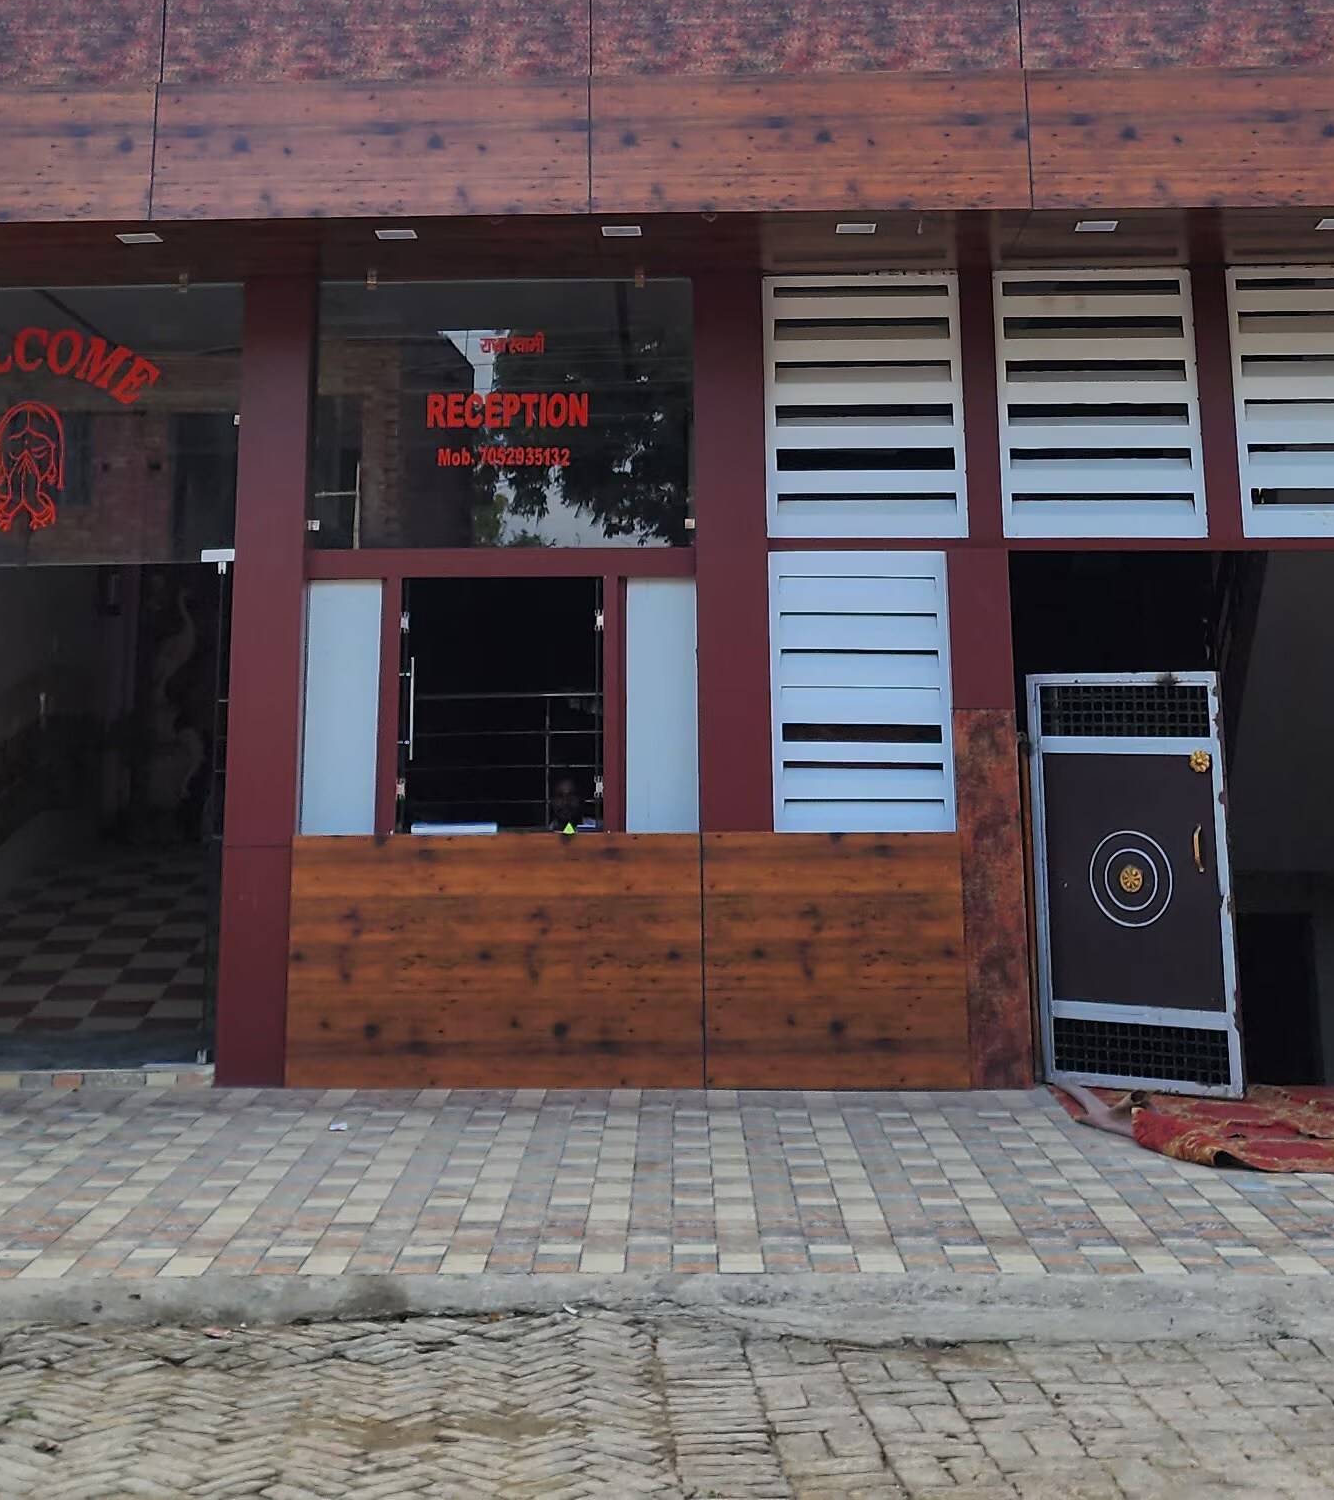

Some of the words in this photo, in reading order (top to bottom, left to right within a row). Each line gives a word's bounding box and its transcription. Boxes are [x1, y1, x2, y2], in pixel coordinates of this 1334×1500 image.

[426, 392, 589, 428] RECEPTION
[436, 447, 474, 467] Mob.
[477, 446, 571, 467] 7052935132
